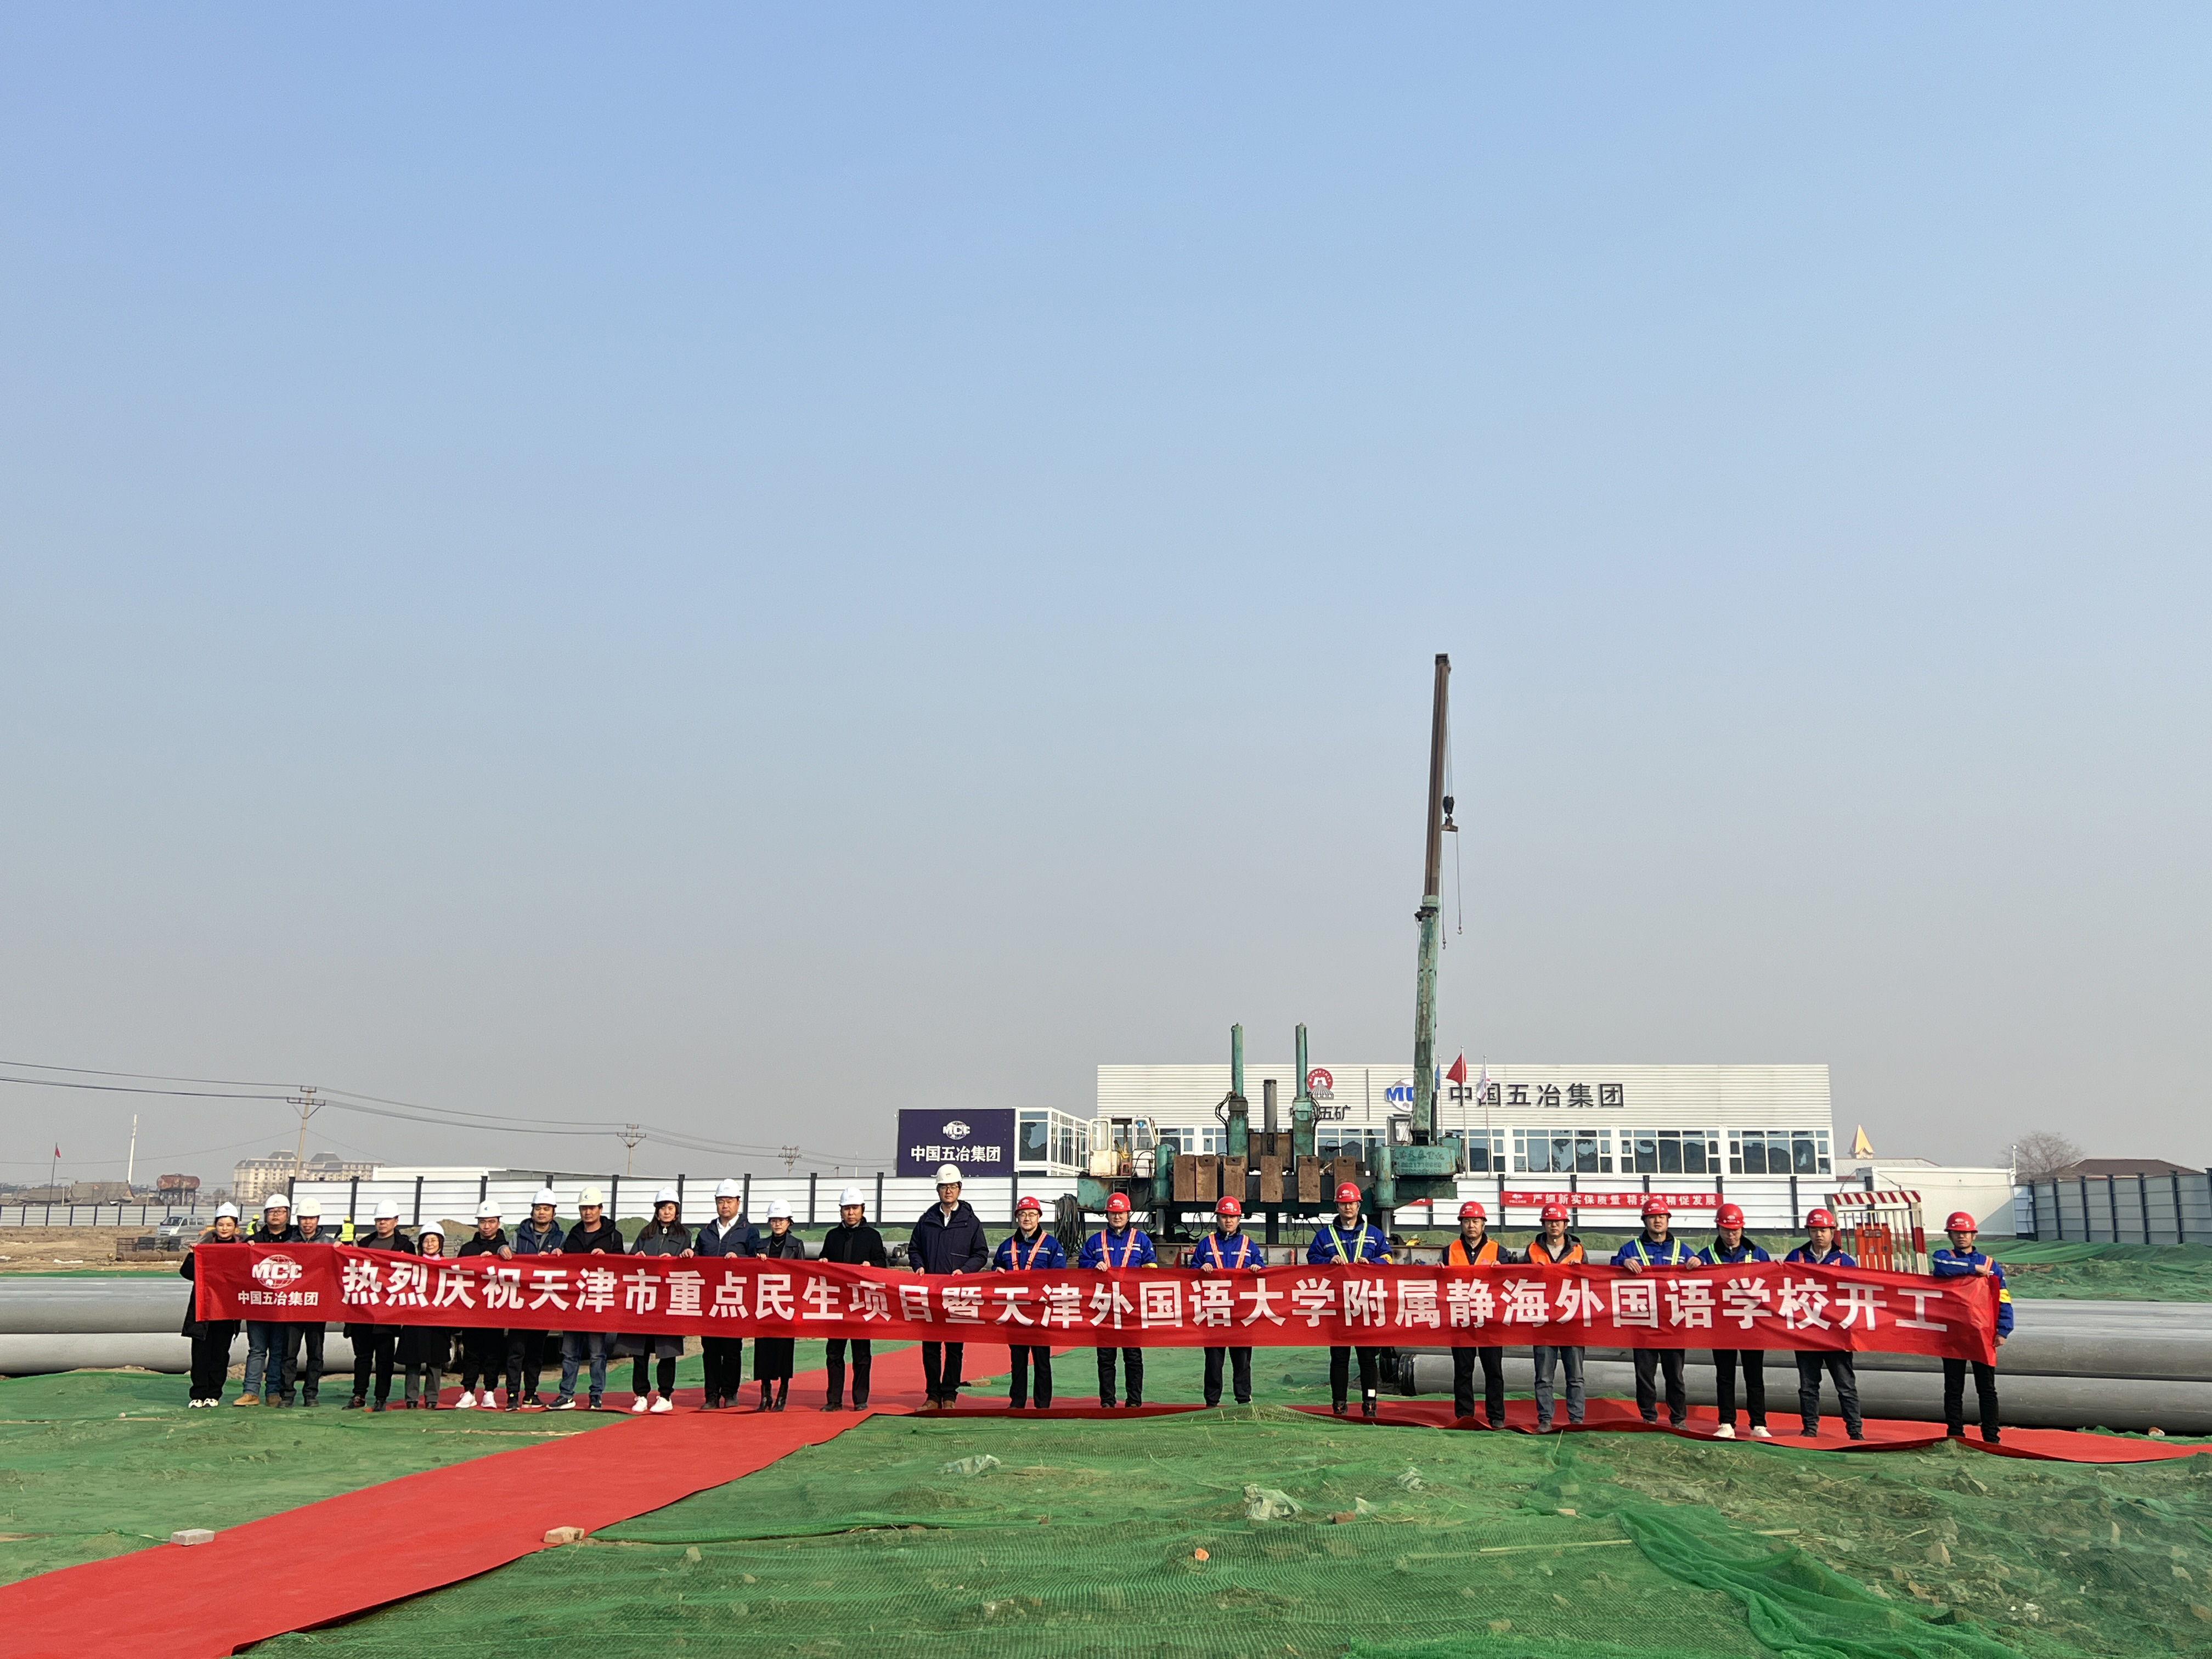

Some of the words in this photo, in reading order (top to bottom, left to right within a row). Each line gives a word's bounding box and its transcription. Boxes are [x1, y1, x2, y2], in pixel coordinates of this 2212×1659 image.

[1450, 1083, 1624, 1107] 中国五冶集团
[943, 1126, 970, 1135] MCC
[911, 1145, 1001, 1162] 中国五冶集团
[252, 1263, 302, 1279] MCC
[238, 1290, 319, 1306] 中国五冶集团
[341, 1258, 1947, 1332] 热烈庆祝天津市重点民生项目暨天津外国语大学附属静海外国语学校开工
